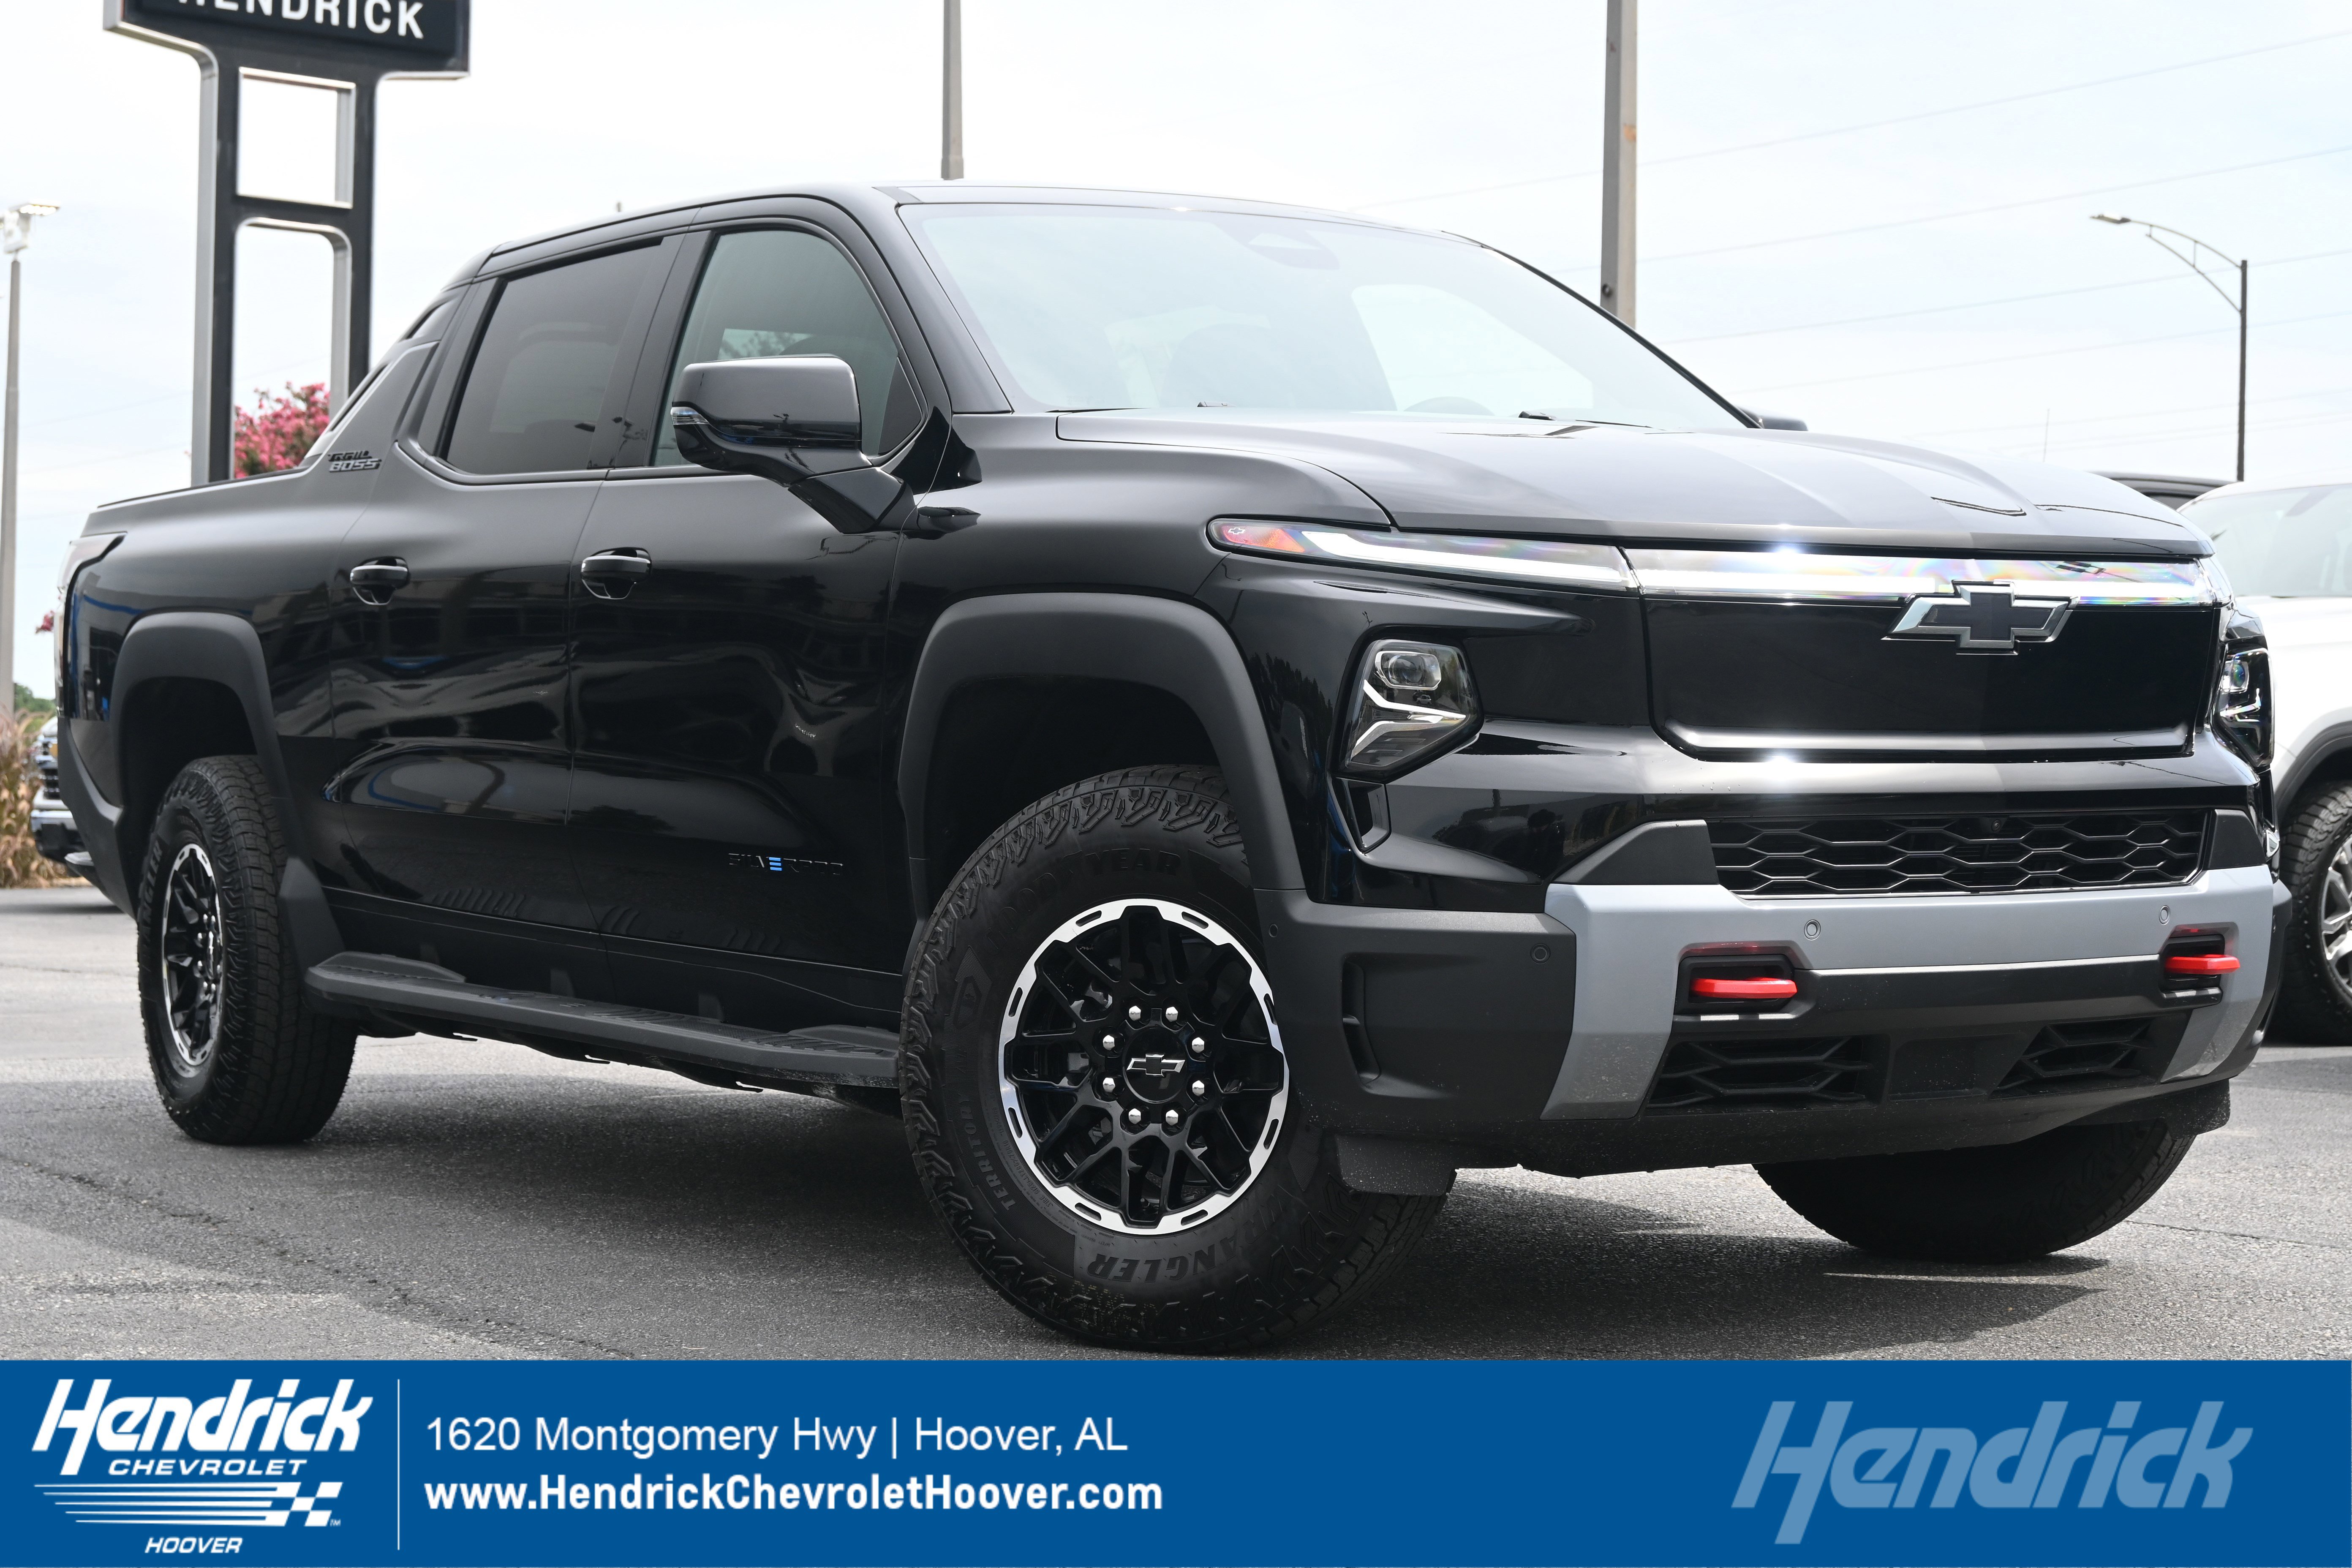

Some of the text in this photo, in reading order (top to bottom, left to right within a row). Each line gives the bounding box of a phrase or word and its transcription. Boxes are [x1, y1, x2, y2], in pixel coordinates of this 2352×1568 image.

[178, 0, 424, 39] DRICK
[329, 459, 382, 473] BOSS
[958, 1091, 1016, 1212] TERRITORY
